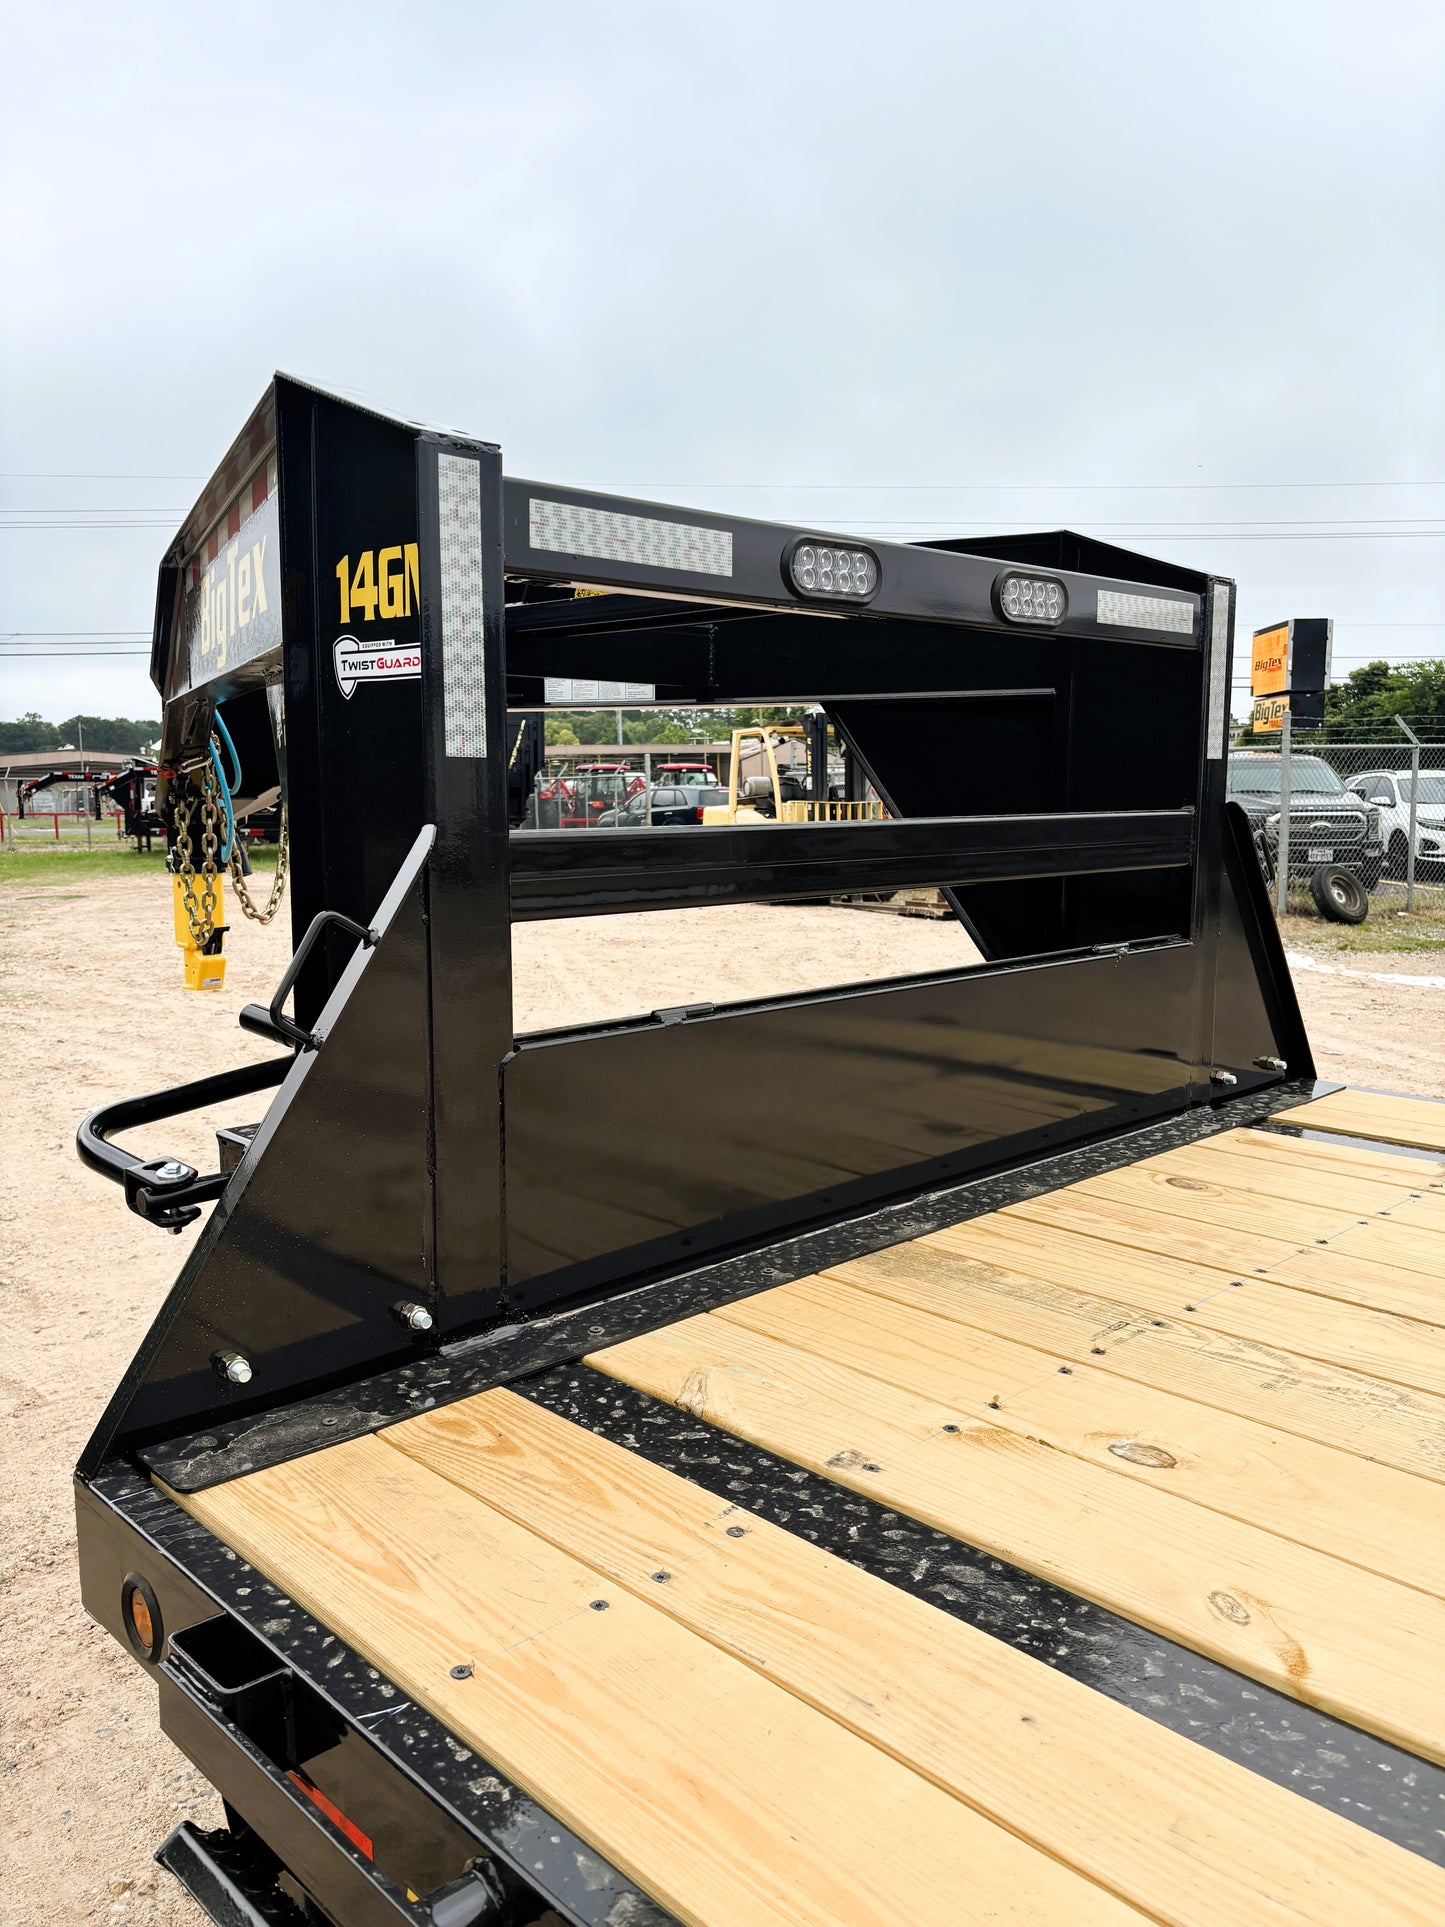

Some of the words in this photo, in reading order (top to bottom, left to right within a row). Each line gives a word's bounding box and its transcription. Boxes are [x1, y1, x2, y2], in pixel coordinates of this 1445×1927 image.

[200, 534, 268, 669] BigTex
[336, 543, 420, 624] 14GN
[1254, 657, 1283, 672] BigTex
